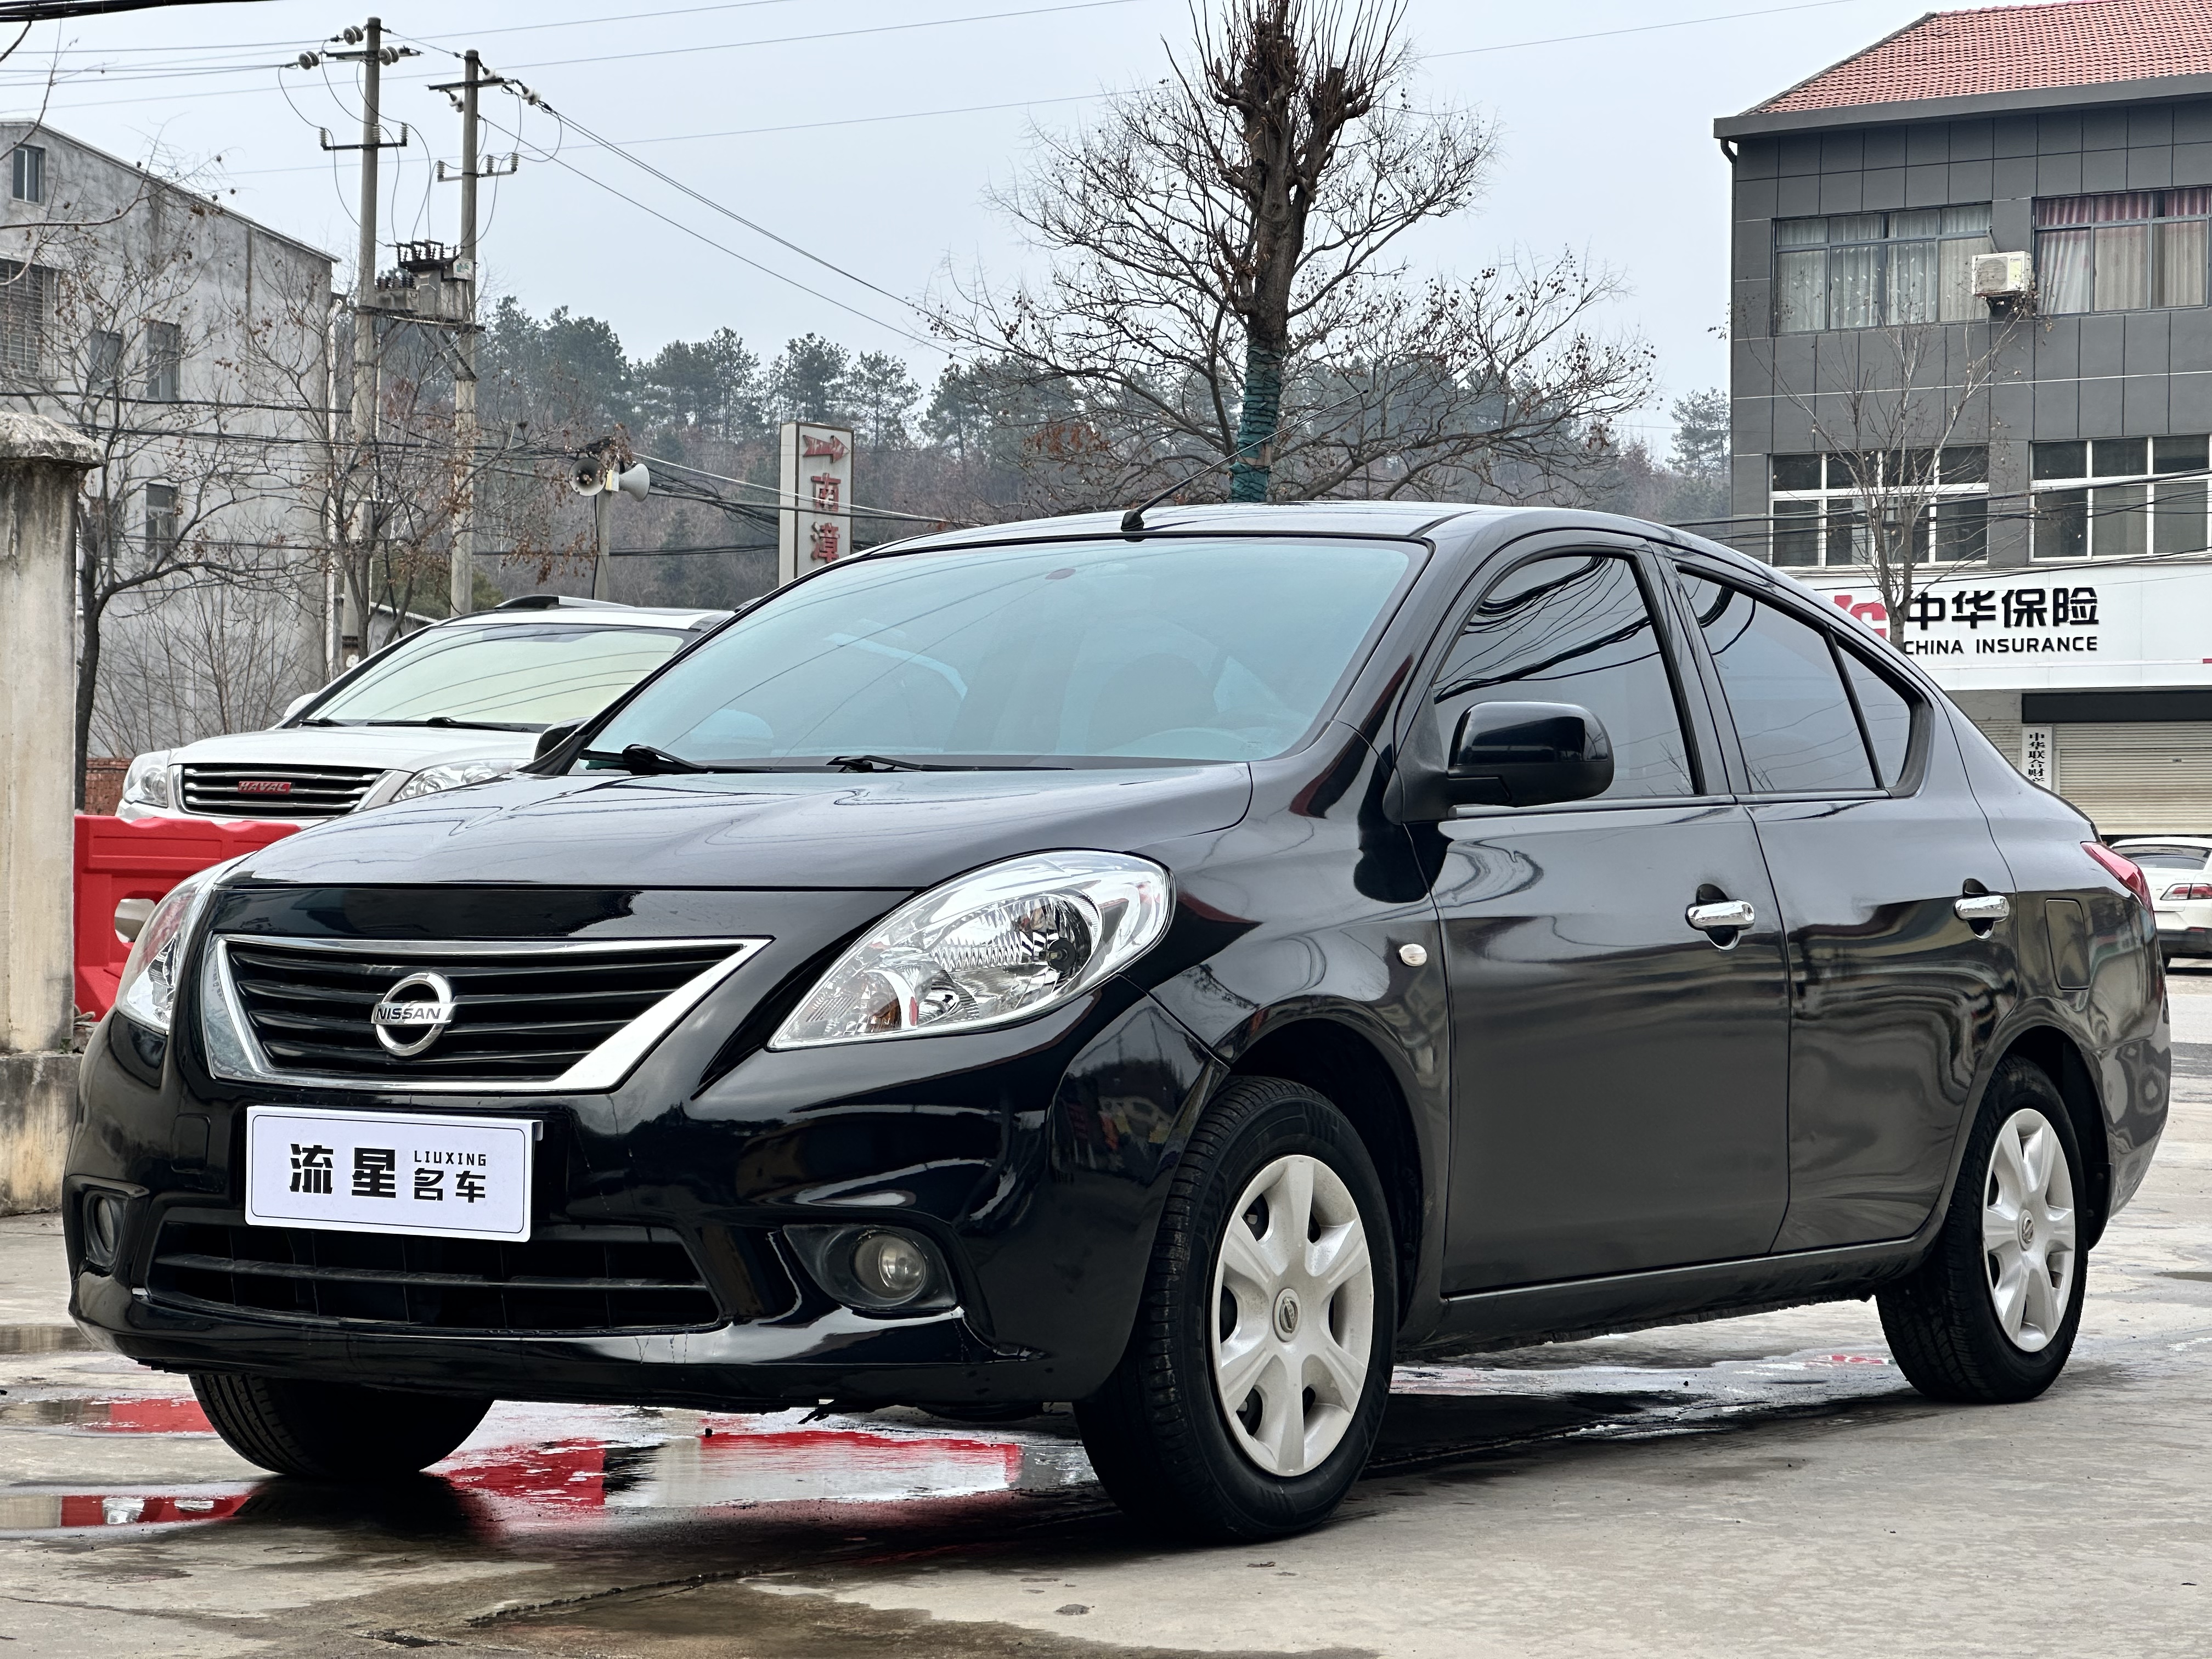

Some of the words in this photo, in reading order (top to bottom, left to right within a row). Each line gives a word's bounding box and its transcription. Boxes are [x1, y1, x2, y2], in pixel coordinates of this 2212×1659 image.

[810, 472, 841, 564] 南漳
[1905, 587, 2099, 630] 中华保险
[1904, 639, 1963, 655] CHINA
[1976, 636, 2098, 654] INSURANCE
[376, 1007, 441, 1020] NISSAN
[414, 1150, 486, 1166] LIUXING
